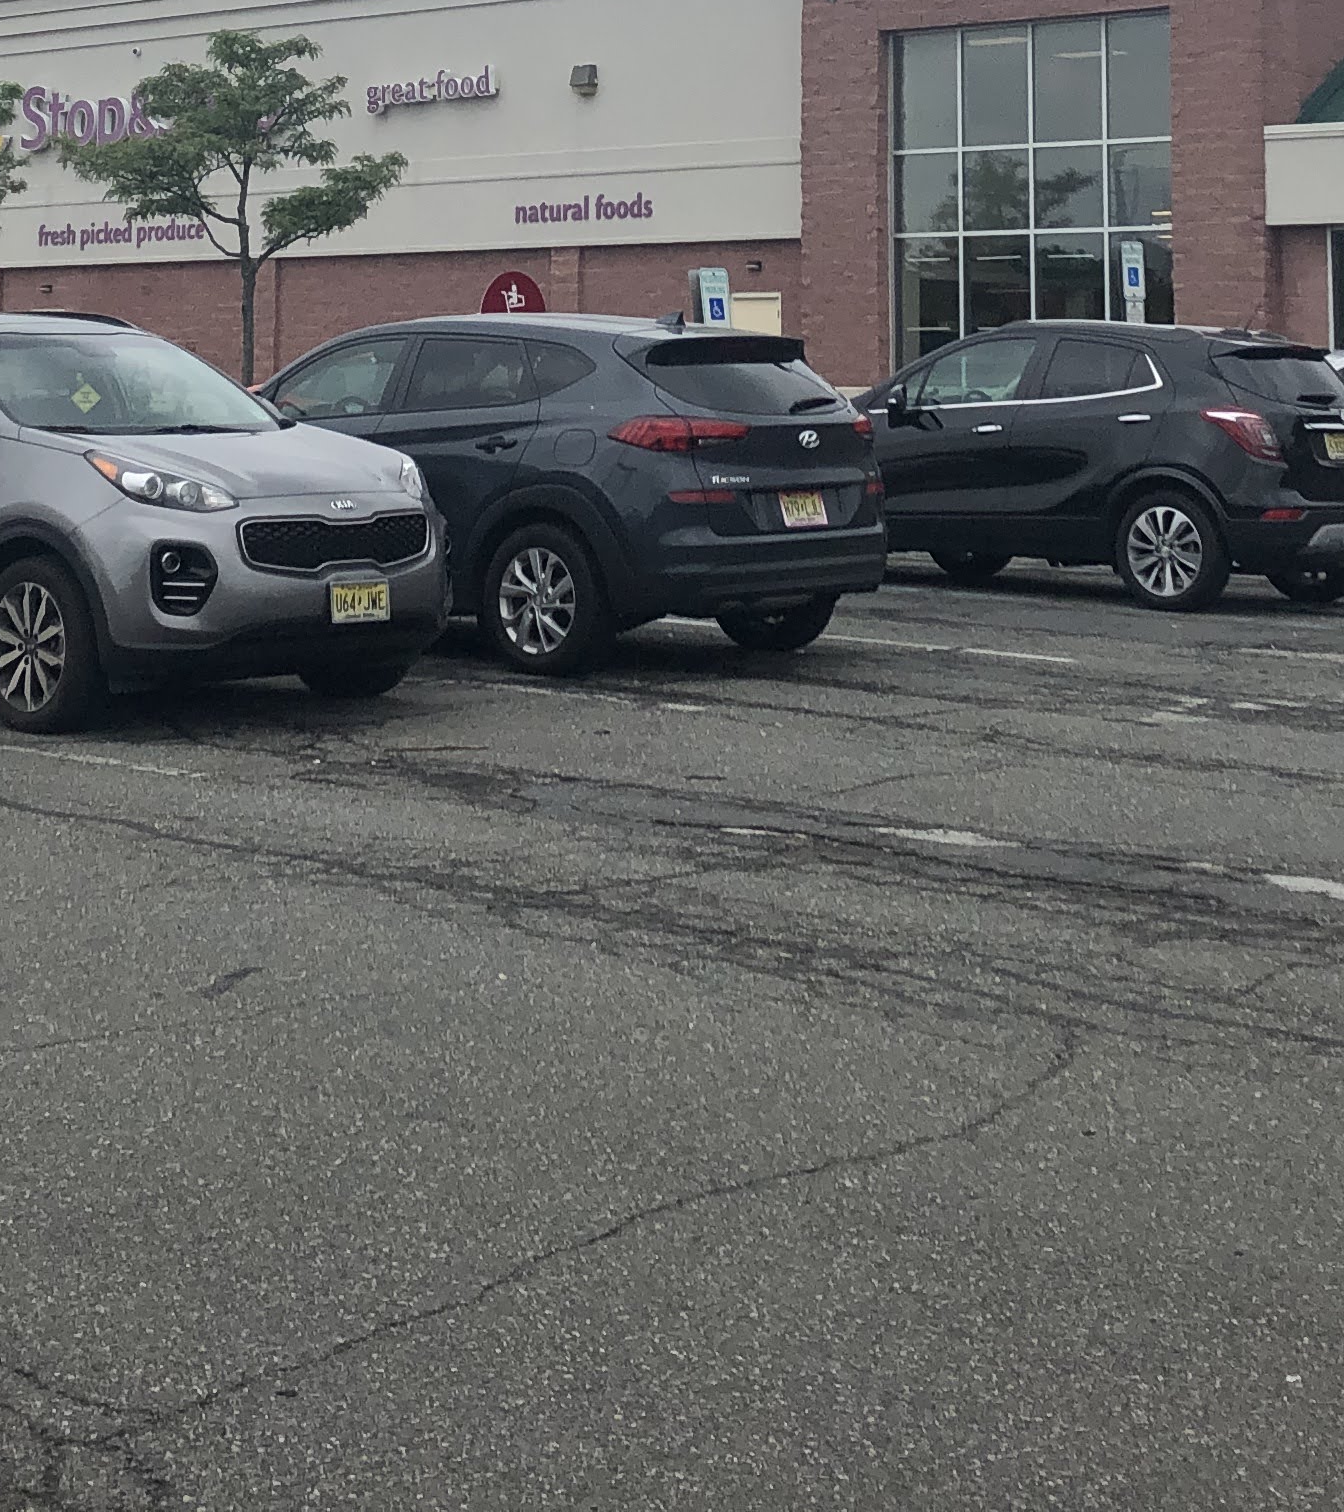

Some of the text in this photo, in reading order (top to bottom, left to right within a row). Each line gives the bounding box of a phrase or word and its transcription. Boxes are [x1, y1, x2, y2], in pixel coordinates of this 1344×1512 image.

[367, 65, 491, 113] great food
[515, 192, 654, 224] natural foods
[38, 217, 205, 251] fresh picked produce
